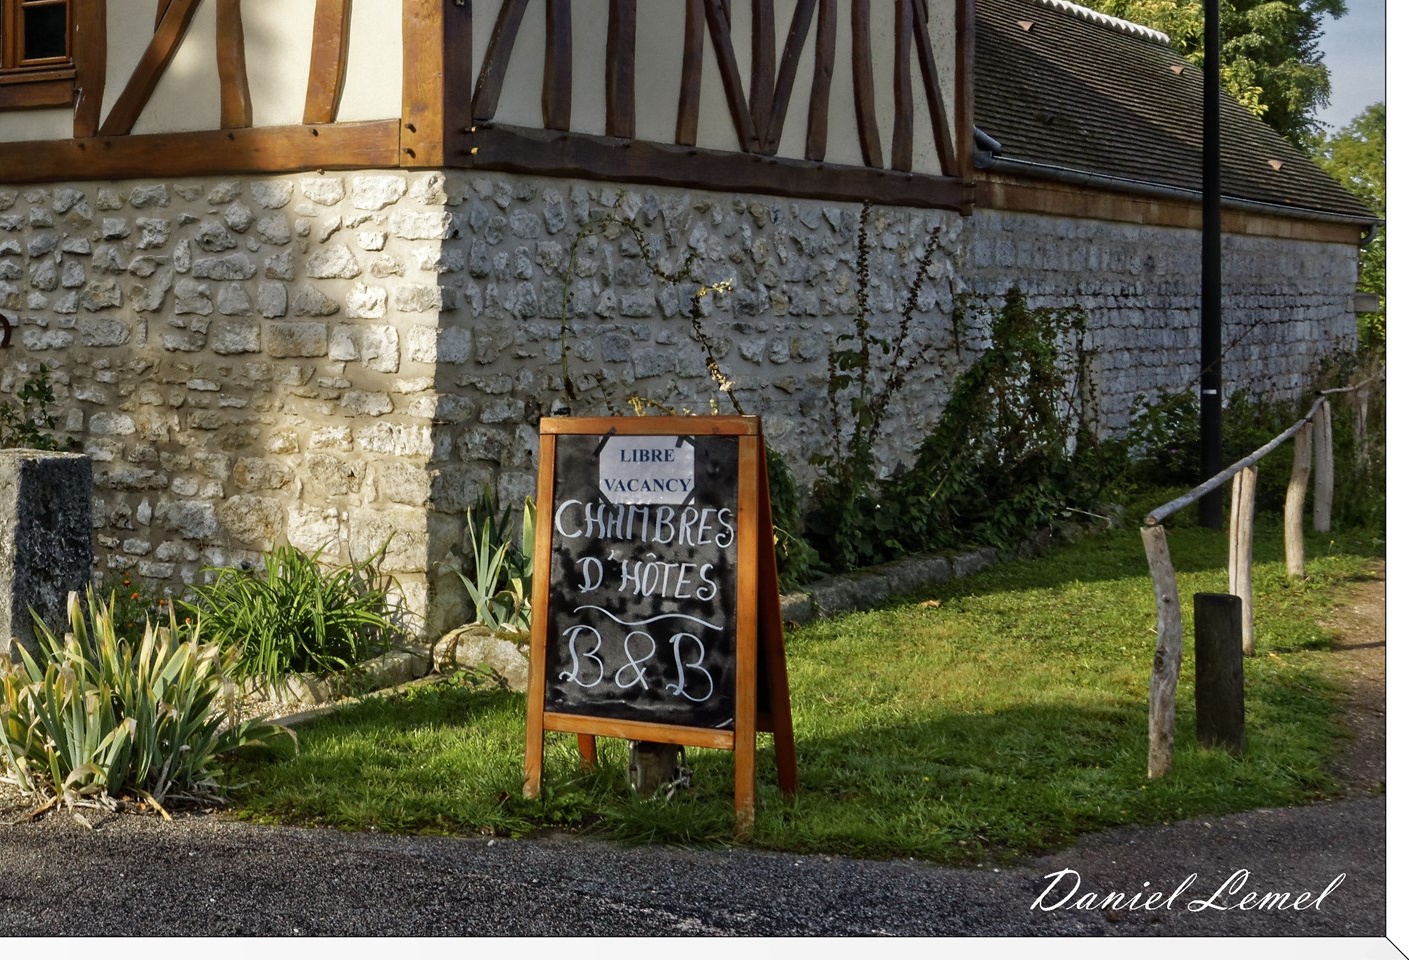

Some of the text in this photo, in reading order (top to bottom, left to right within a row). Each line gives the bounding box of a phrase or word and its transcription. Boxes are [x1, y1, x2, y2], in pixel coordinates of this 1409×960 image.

[620, 448, 675, 462] LIBRE
[604, 478, 692, 492] VACANCY
[555, 499, 734, 548] CHAMBRES
